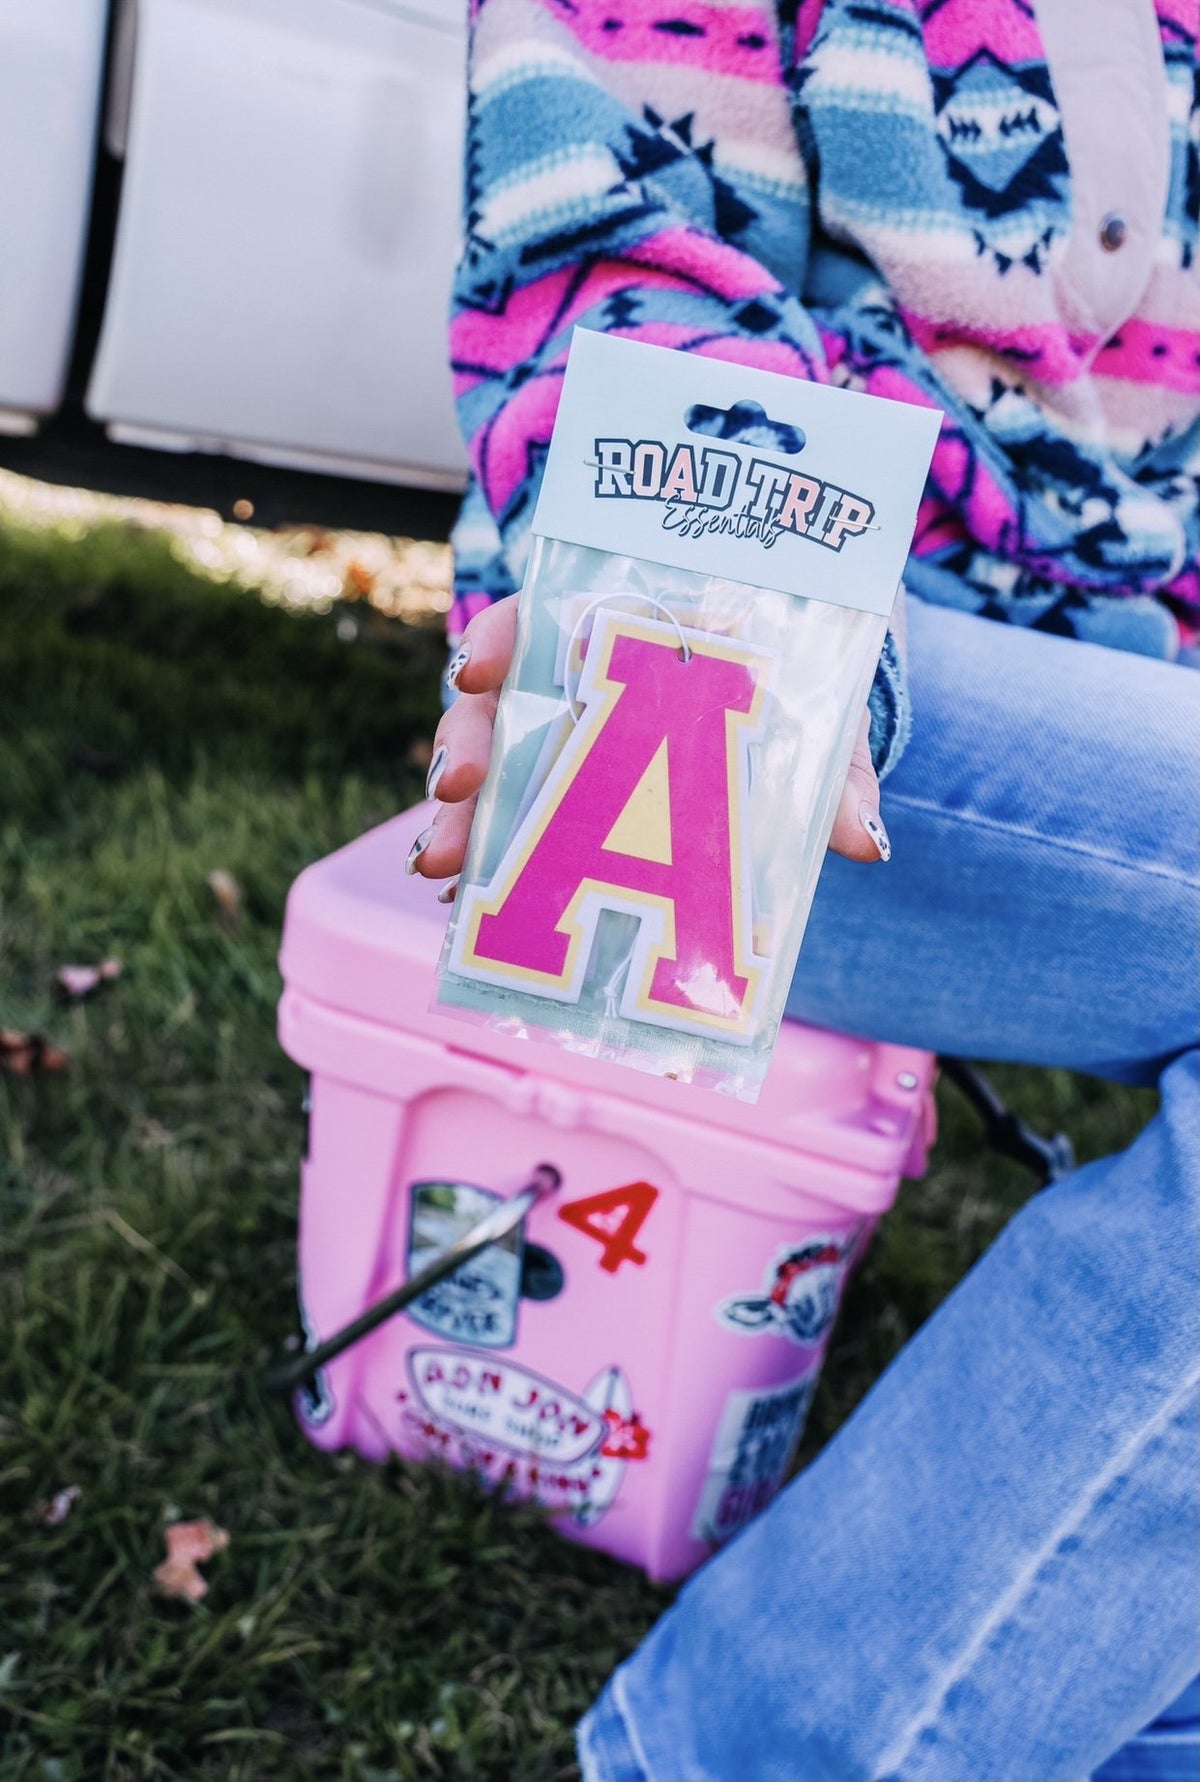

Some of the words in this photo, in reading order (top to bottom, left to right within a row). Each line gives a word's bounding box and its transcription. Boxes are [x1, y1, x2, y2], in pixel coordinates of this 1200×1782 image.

[594, 438, 742, 511] ROAD
[745, 458, 875, 553] TRIP
[661, 491, 787, 549] Essentials
[473, 634, 756, 1020] A
[558, 1181, 659, 1273] 4
